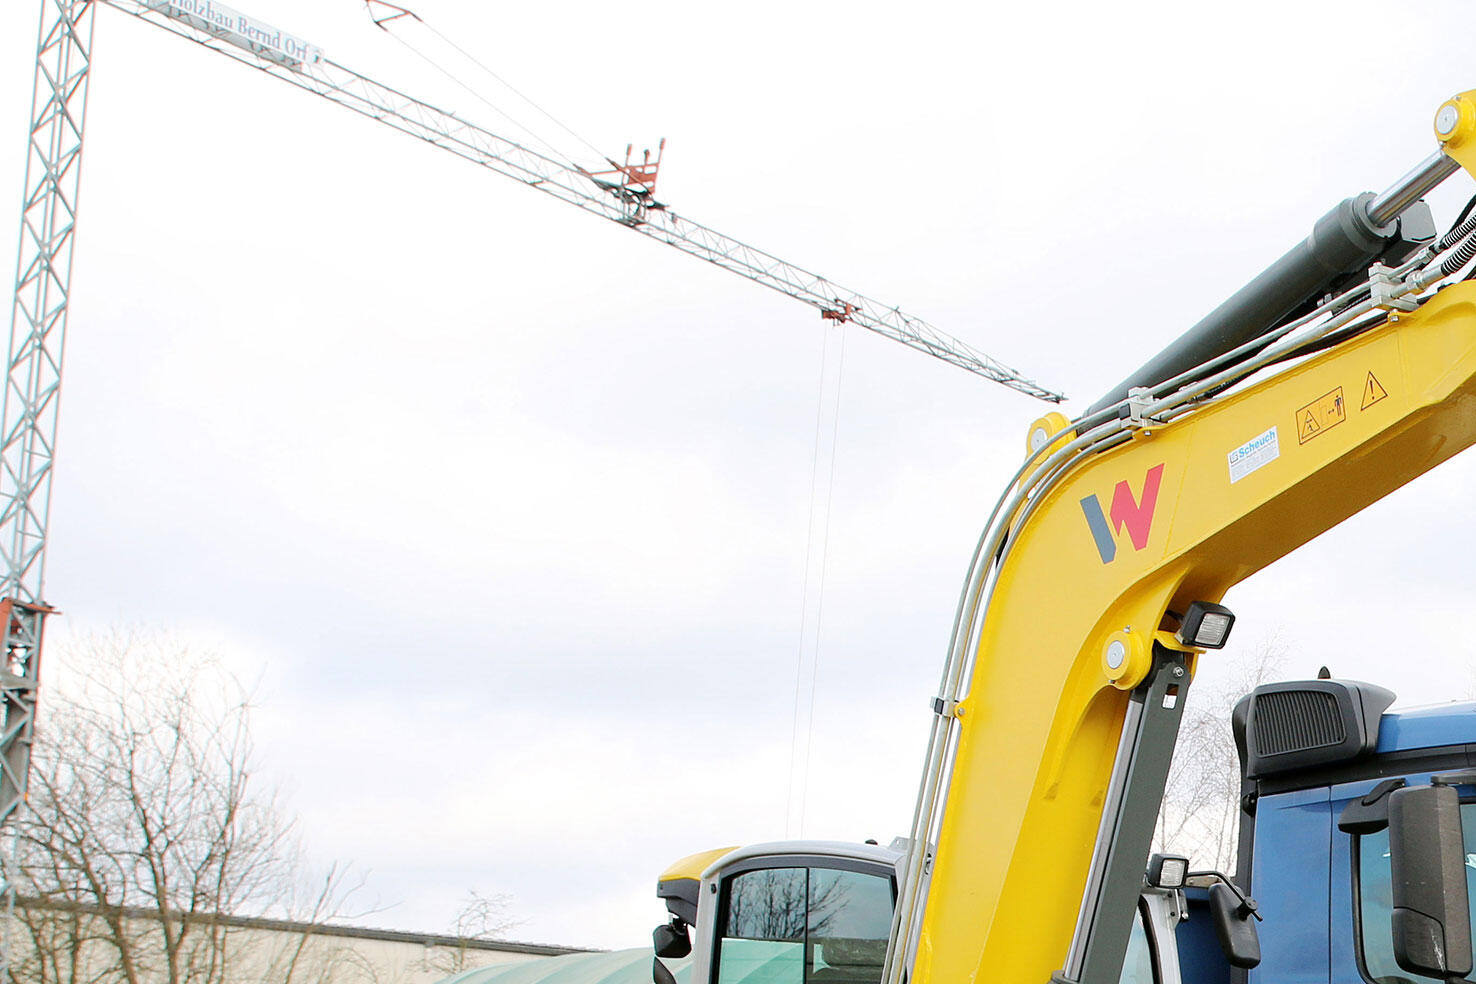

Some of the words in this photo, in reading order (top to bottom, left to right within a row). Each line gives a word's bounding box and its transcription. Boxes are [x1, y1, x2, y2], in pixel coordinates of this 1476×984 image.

[170, 0, 233, 29] olzbau
[237, 15, 280, 49] Bernd
[1238, 430, 1276, 459] Scheuch
